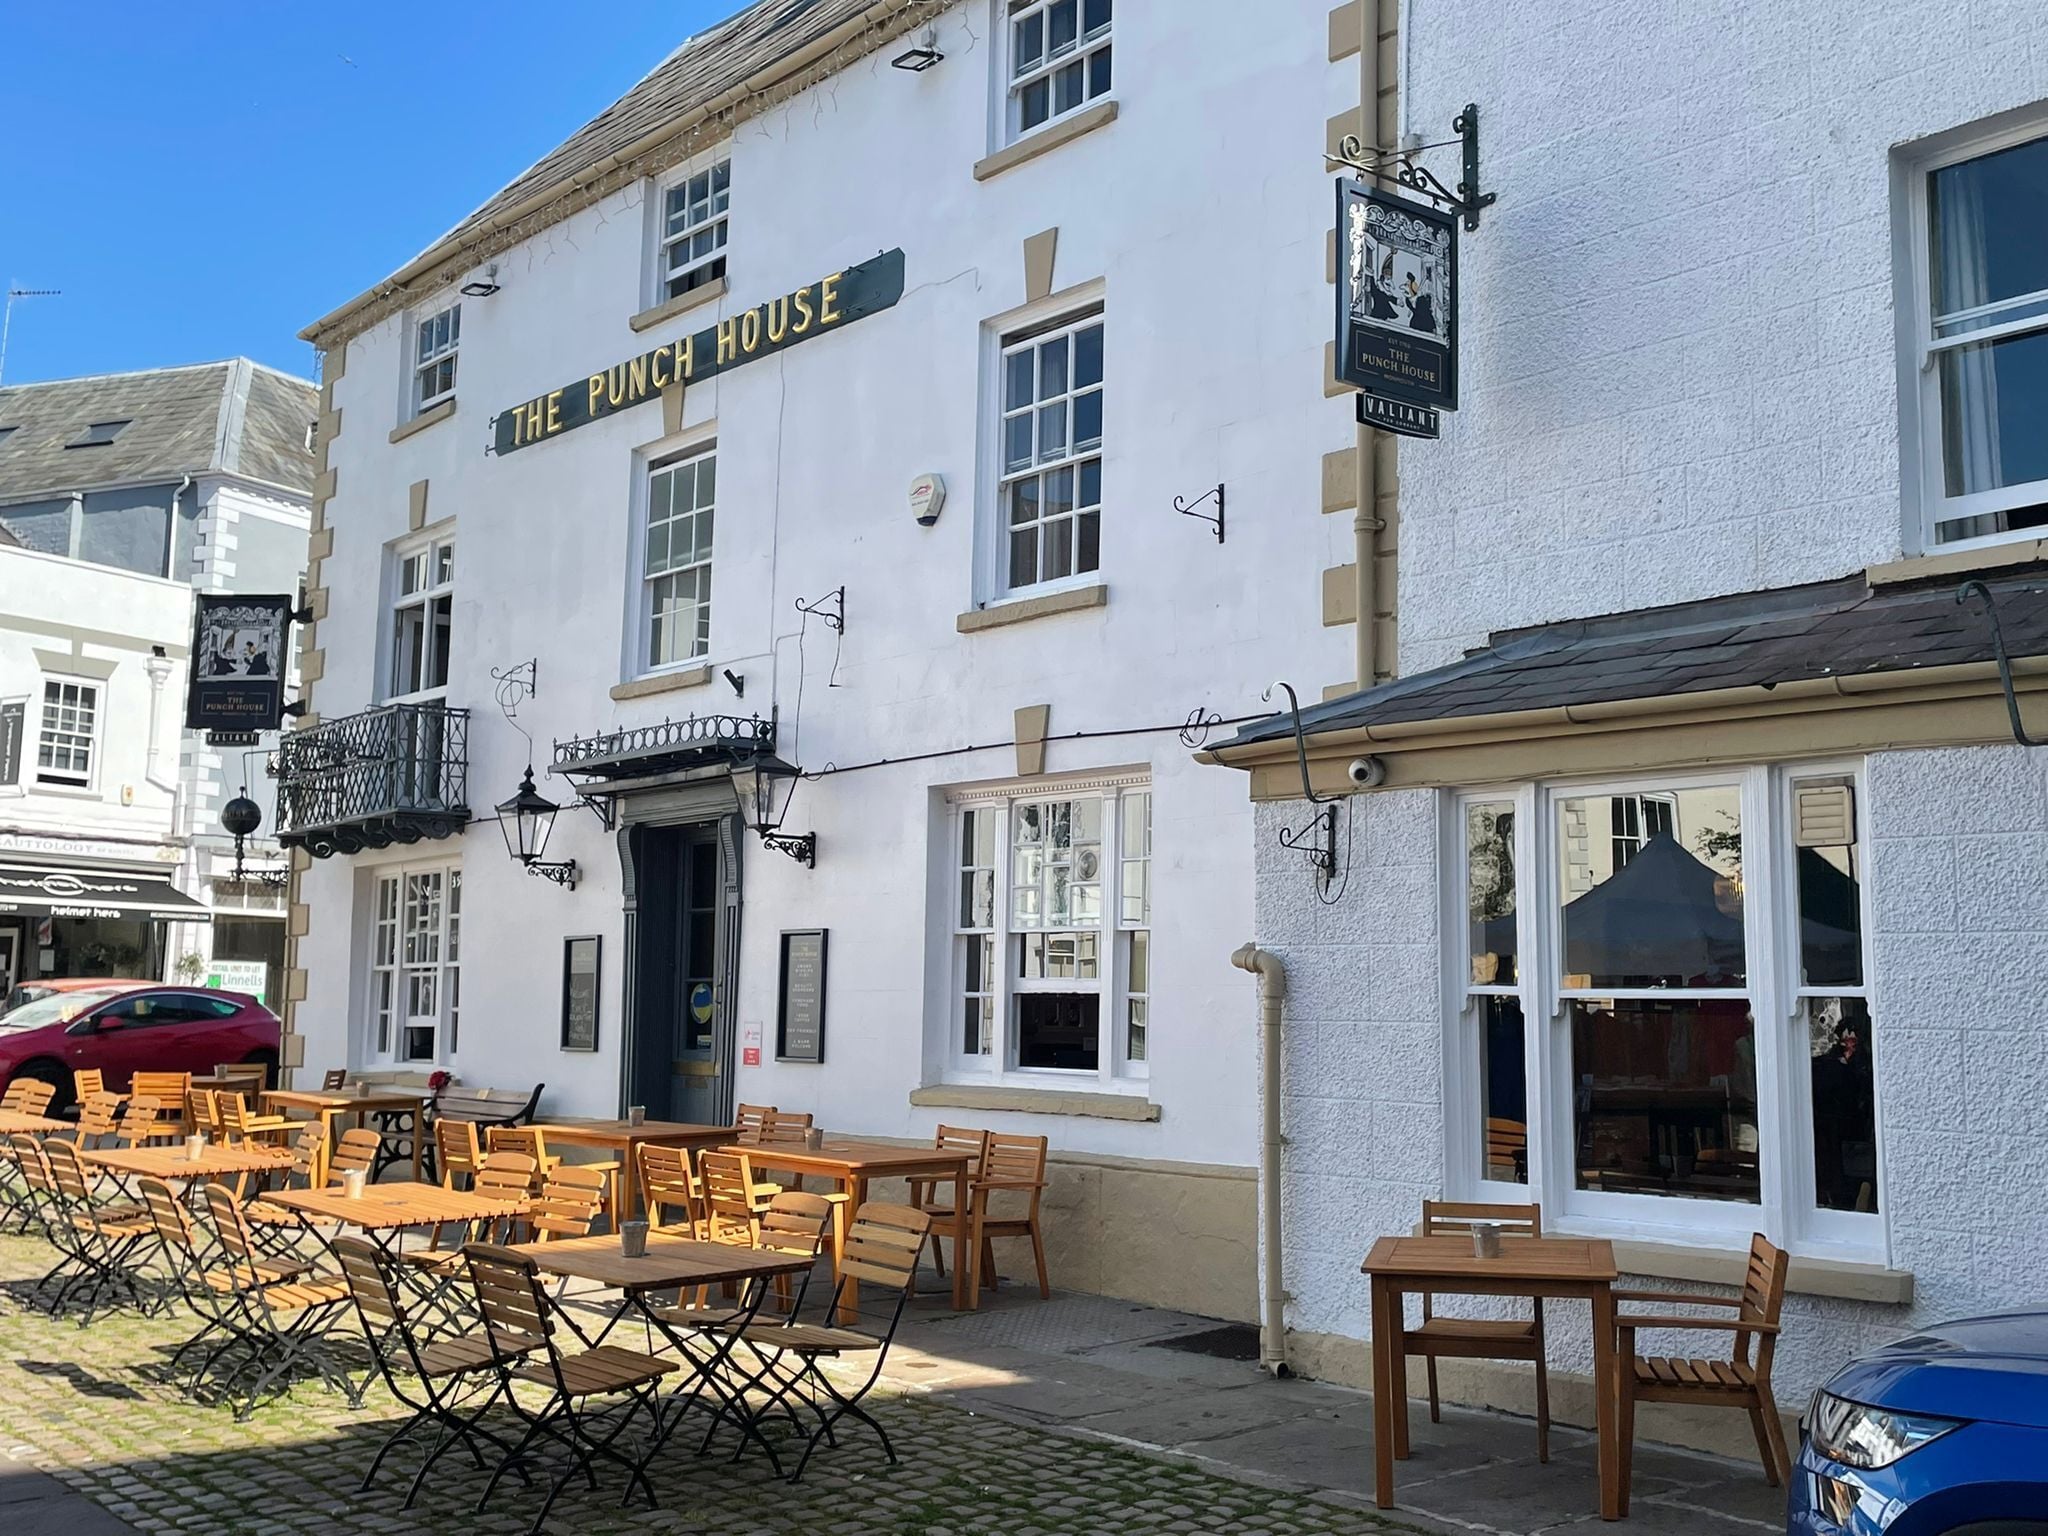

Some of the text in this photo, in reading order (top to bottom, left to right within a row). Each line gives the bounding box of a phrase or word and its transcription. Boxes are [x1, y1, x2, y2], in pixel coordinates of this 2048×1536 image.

[511, 271, 843, 446] THE PUNCH HOUSE
[1388, 348, 1411, 363] THE
[1362, 352, 1398, 372] PUNCH
[1401, 364, 1436, 382] HOUSE
[1366, 397, 1436, 429] VALIANT
[206, 703, 234, 711] PUNCH
[207, 734, 255, 743] VALIANT
[222, 973, 263, 986] Linnells
